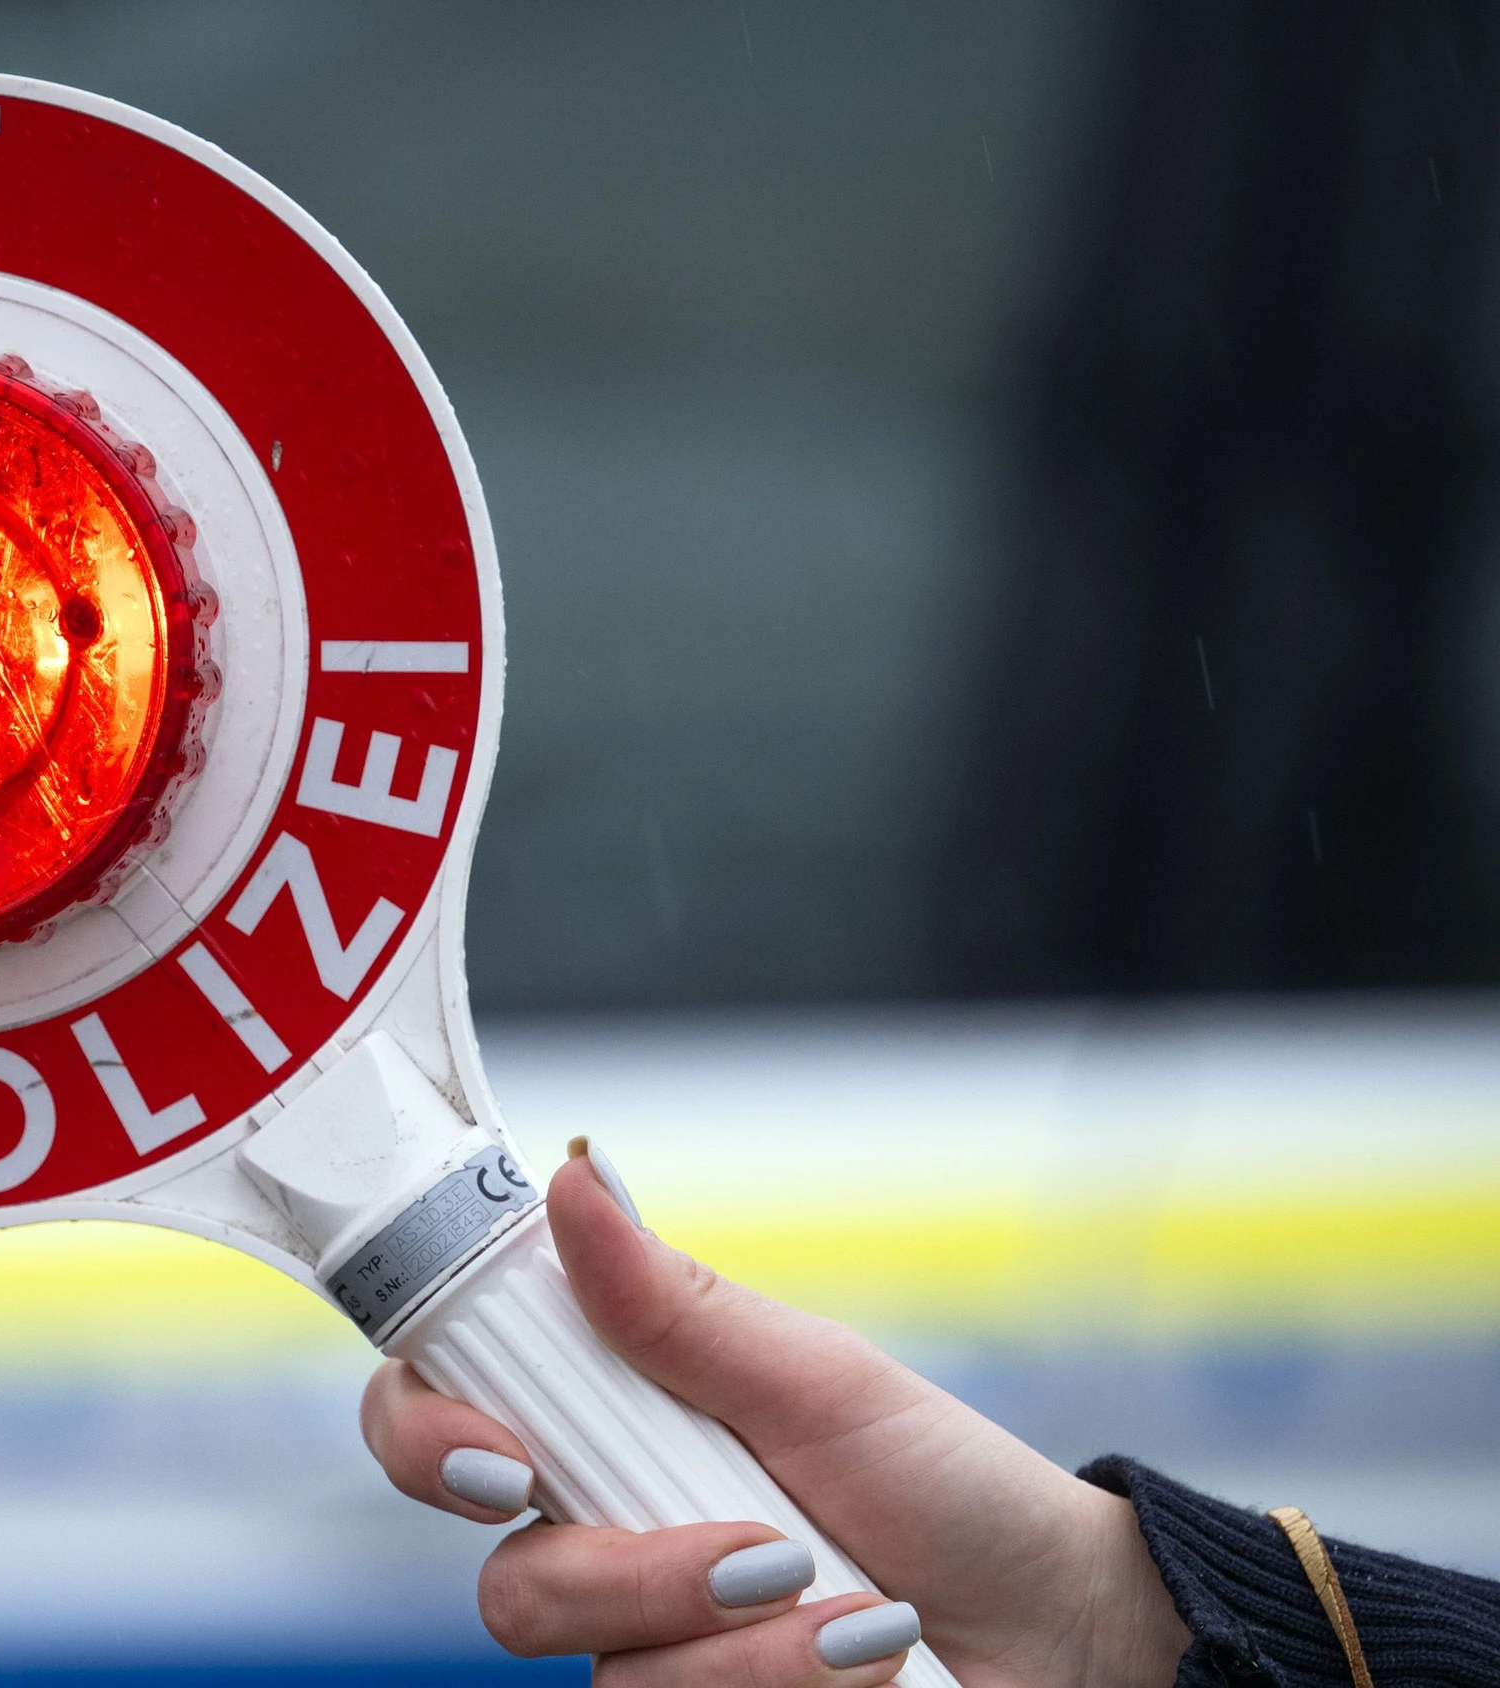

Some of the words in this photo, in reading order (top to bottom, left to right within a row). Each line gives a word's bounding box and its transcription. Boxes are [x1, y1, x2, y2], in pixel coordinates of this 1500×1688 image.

[477, 1154, 529, 1203] CE
[357, 1254, 389, 1282] TYP:
[375, 1271, 410, 1303] S.Nr.:
[411, 1207, 485, 1273] 20021845
